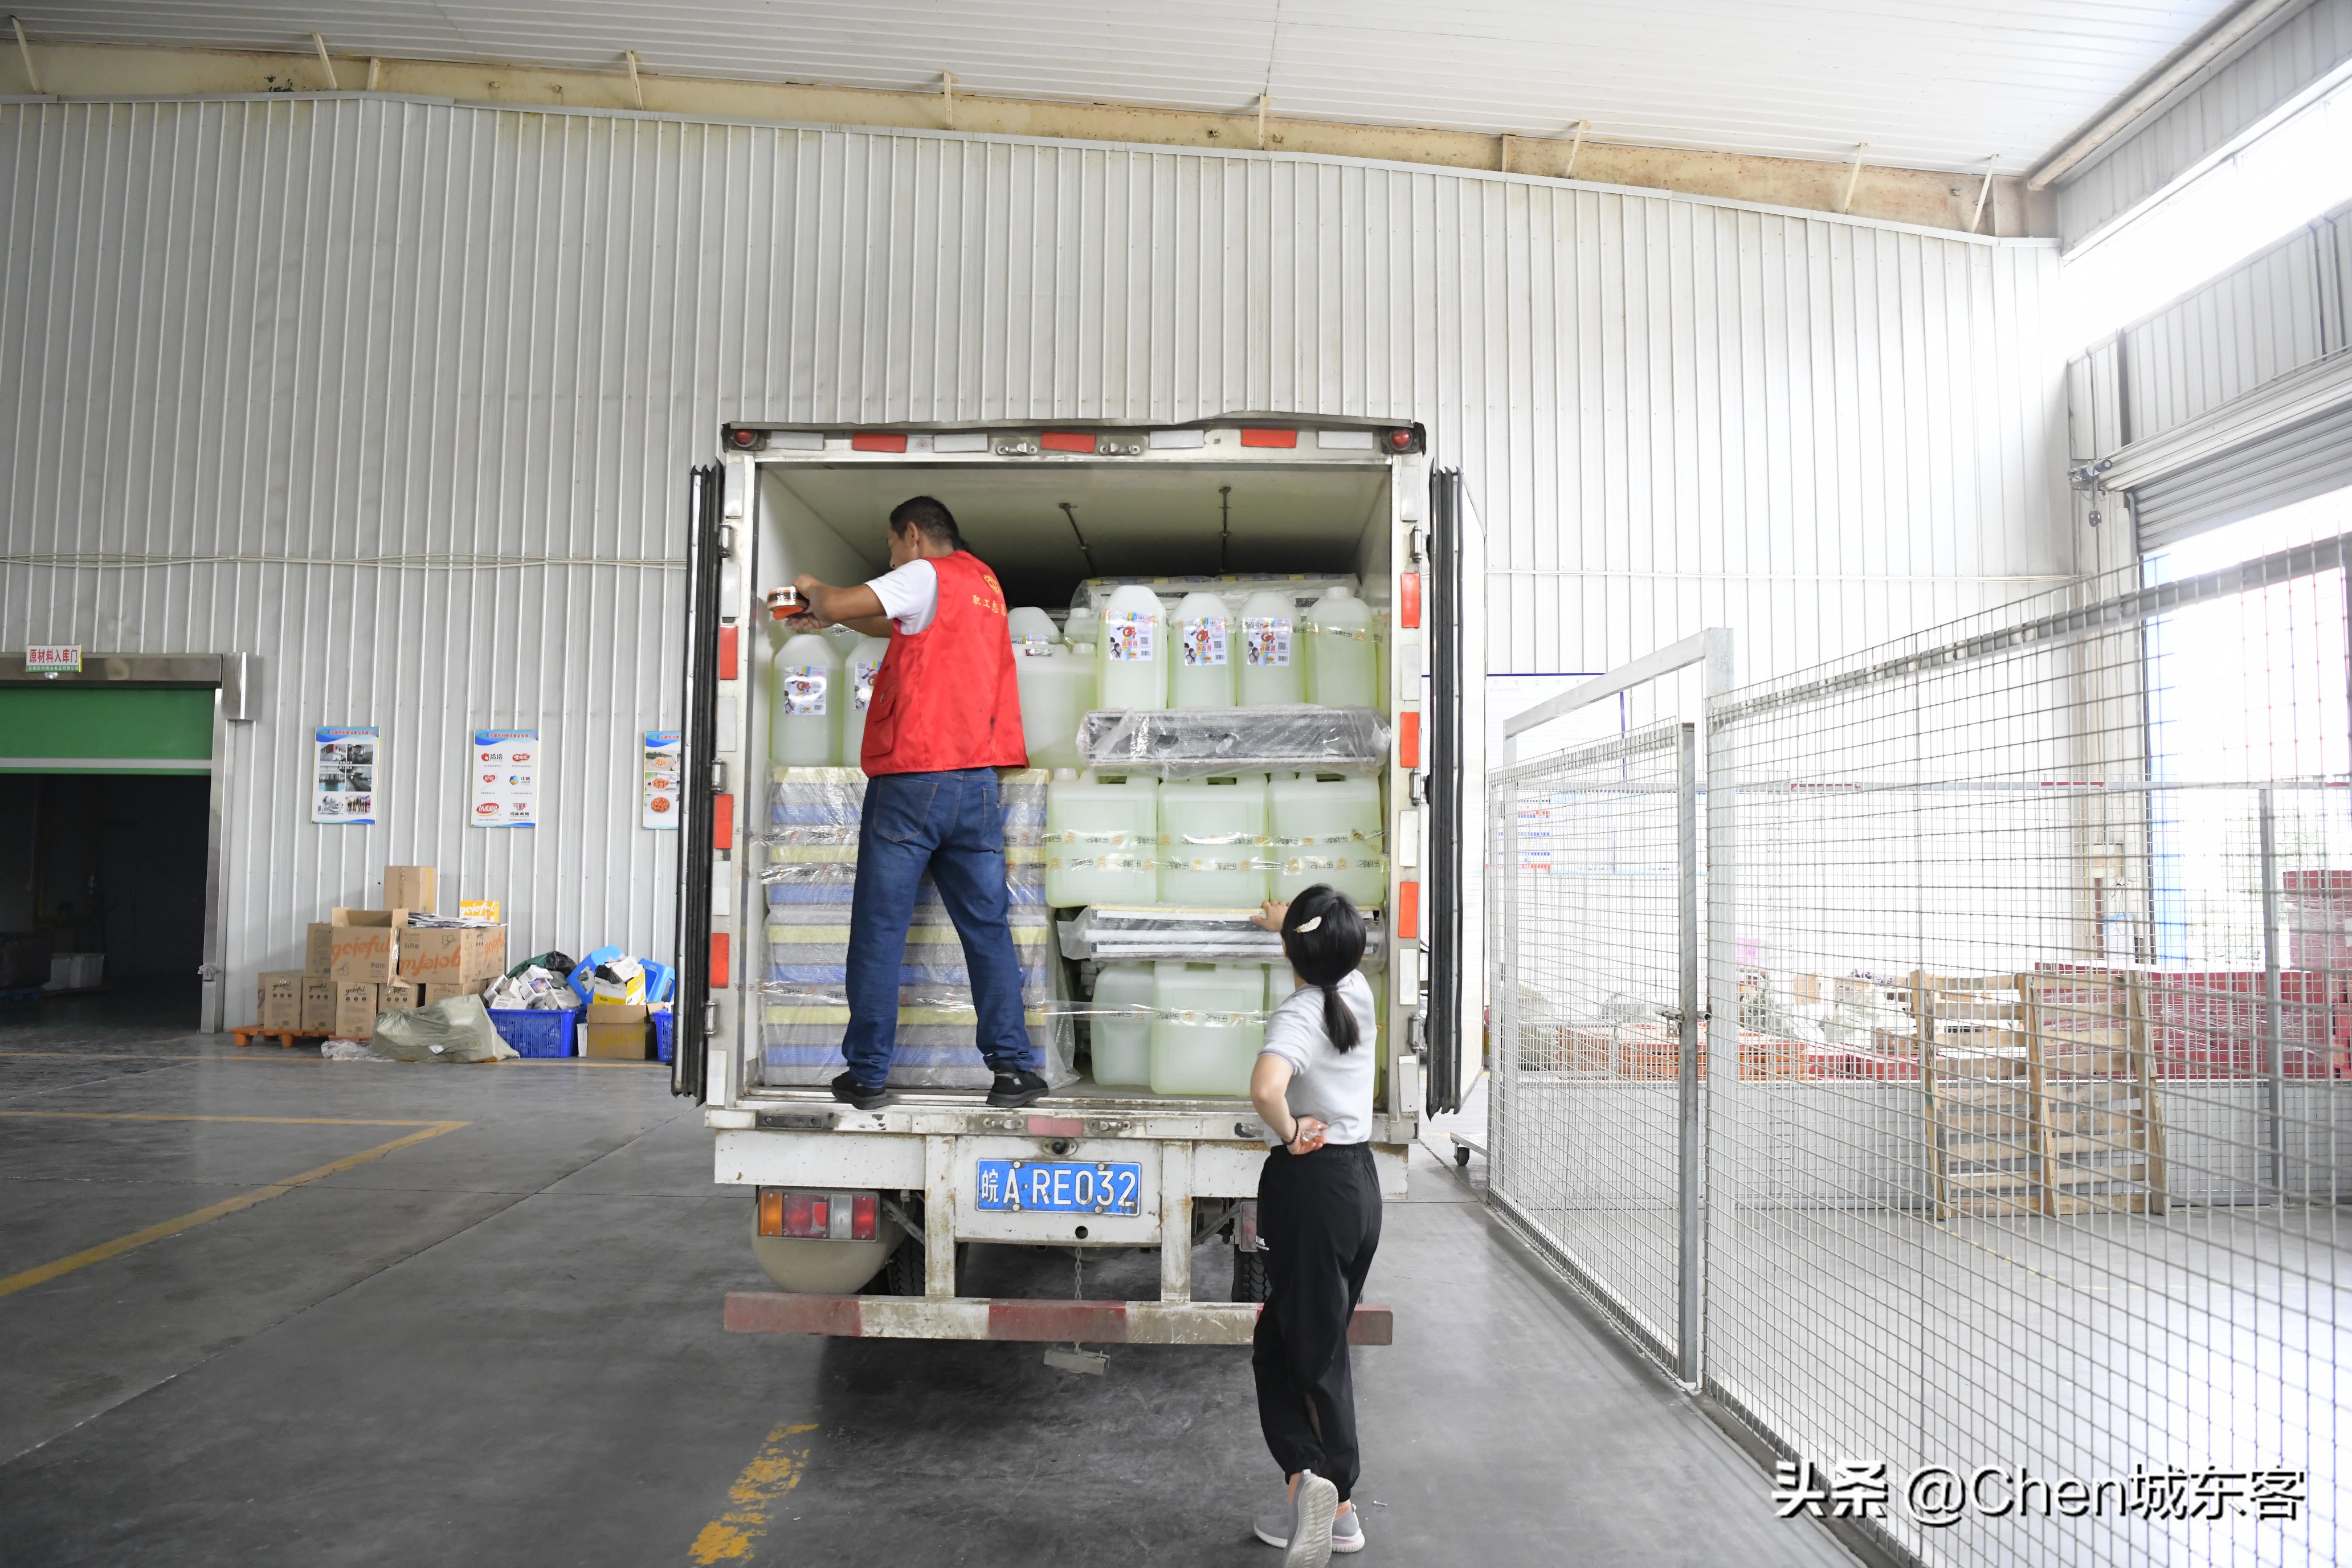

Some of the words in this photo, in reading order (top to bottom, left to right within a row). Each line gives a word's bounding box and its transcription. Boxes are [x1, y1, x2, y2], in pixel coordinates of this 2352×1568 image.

[30, 648, 77, 664] 原材料入库门
[982, 1168, 1136, 1207] 皖A·RE032
